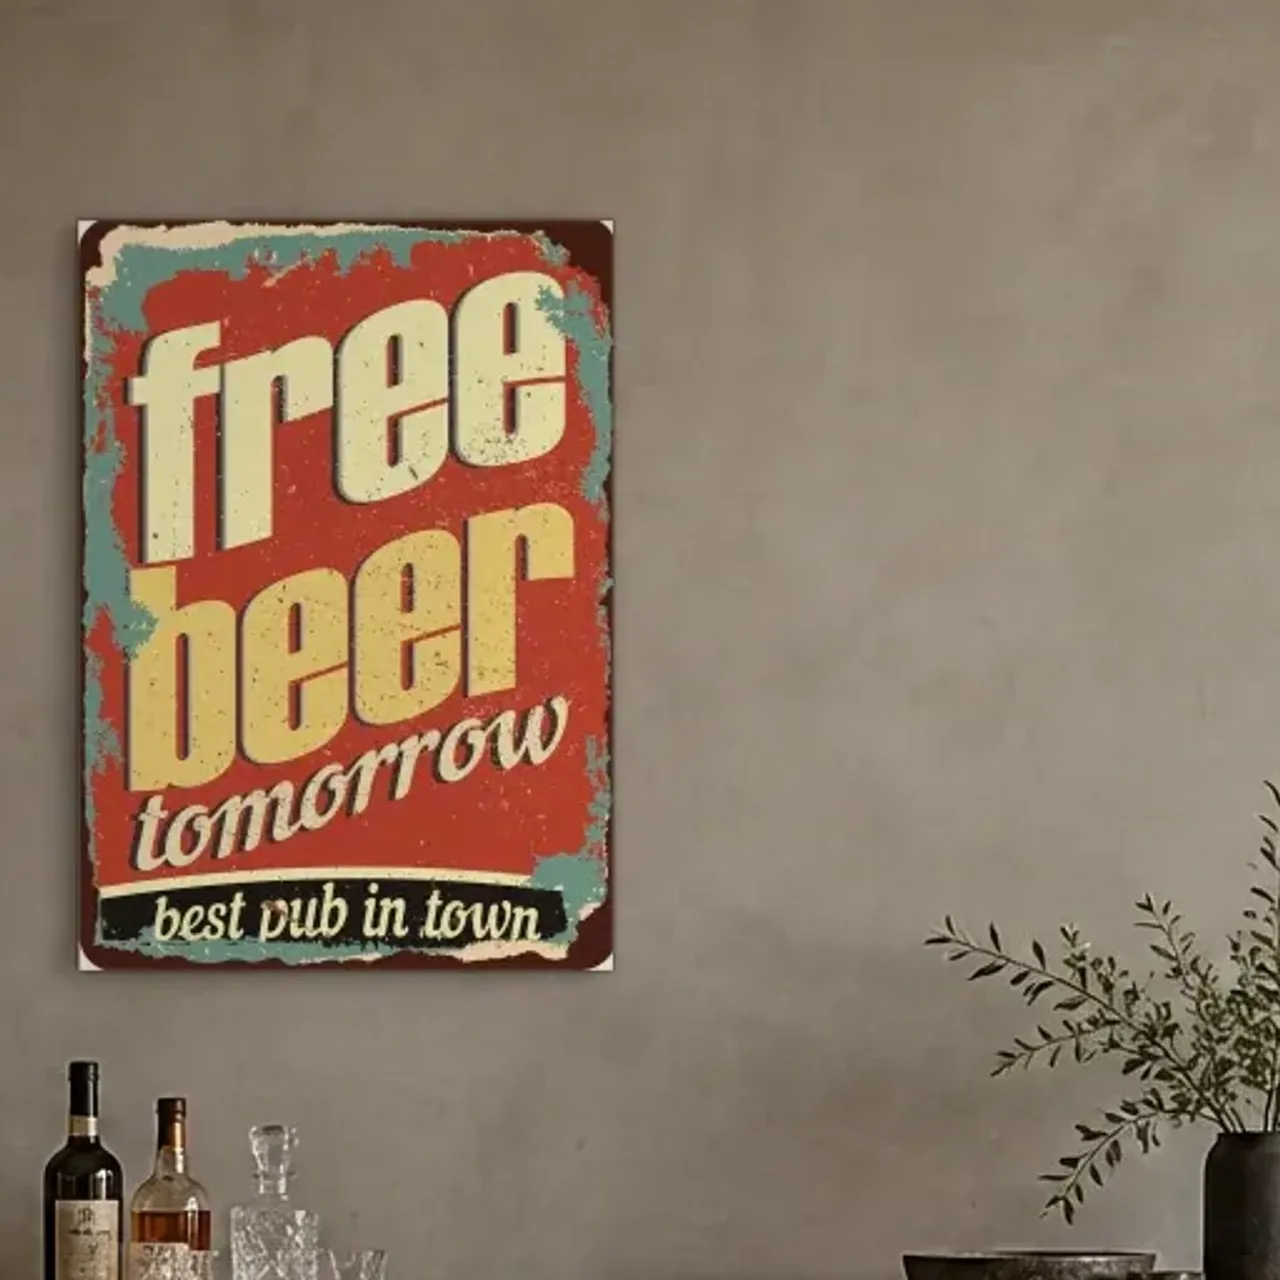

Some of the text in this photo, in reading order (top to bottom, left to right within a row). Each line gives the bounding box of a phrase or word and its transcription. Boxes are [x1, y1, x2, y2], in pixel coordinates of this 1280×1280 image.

[130, 271, 567, 564] free
[129, 501, 575, 792] beer
[135, 695, 569, 871] tomorrow
[154, 882, 542, 942] best pub in town
